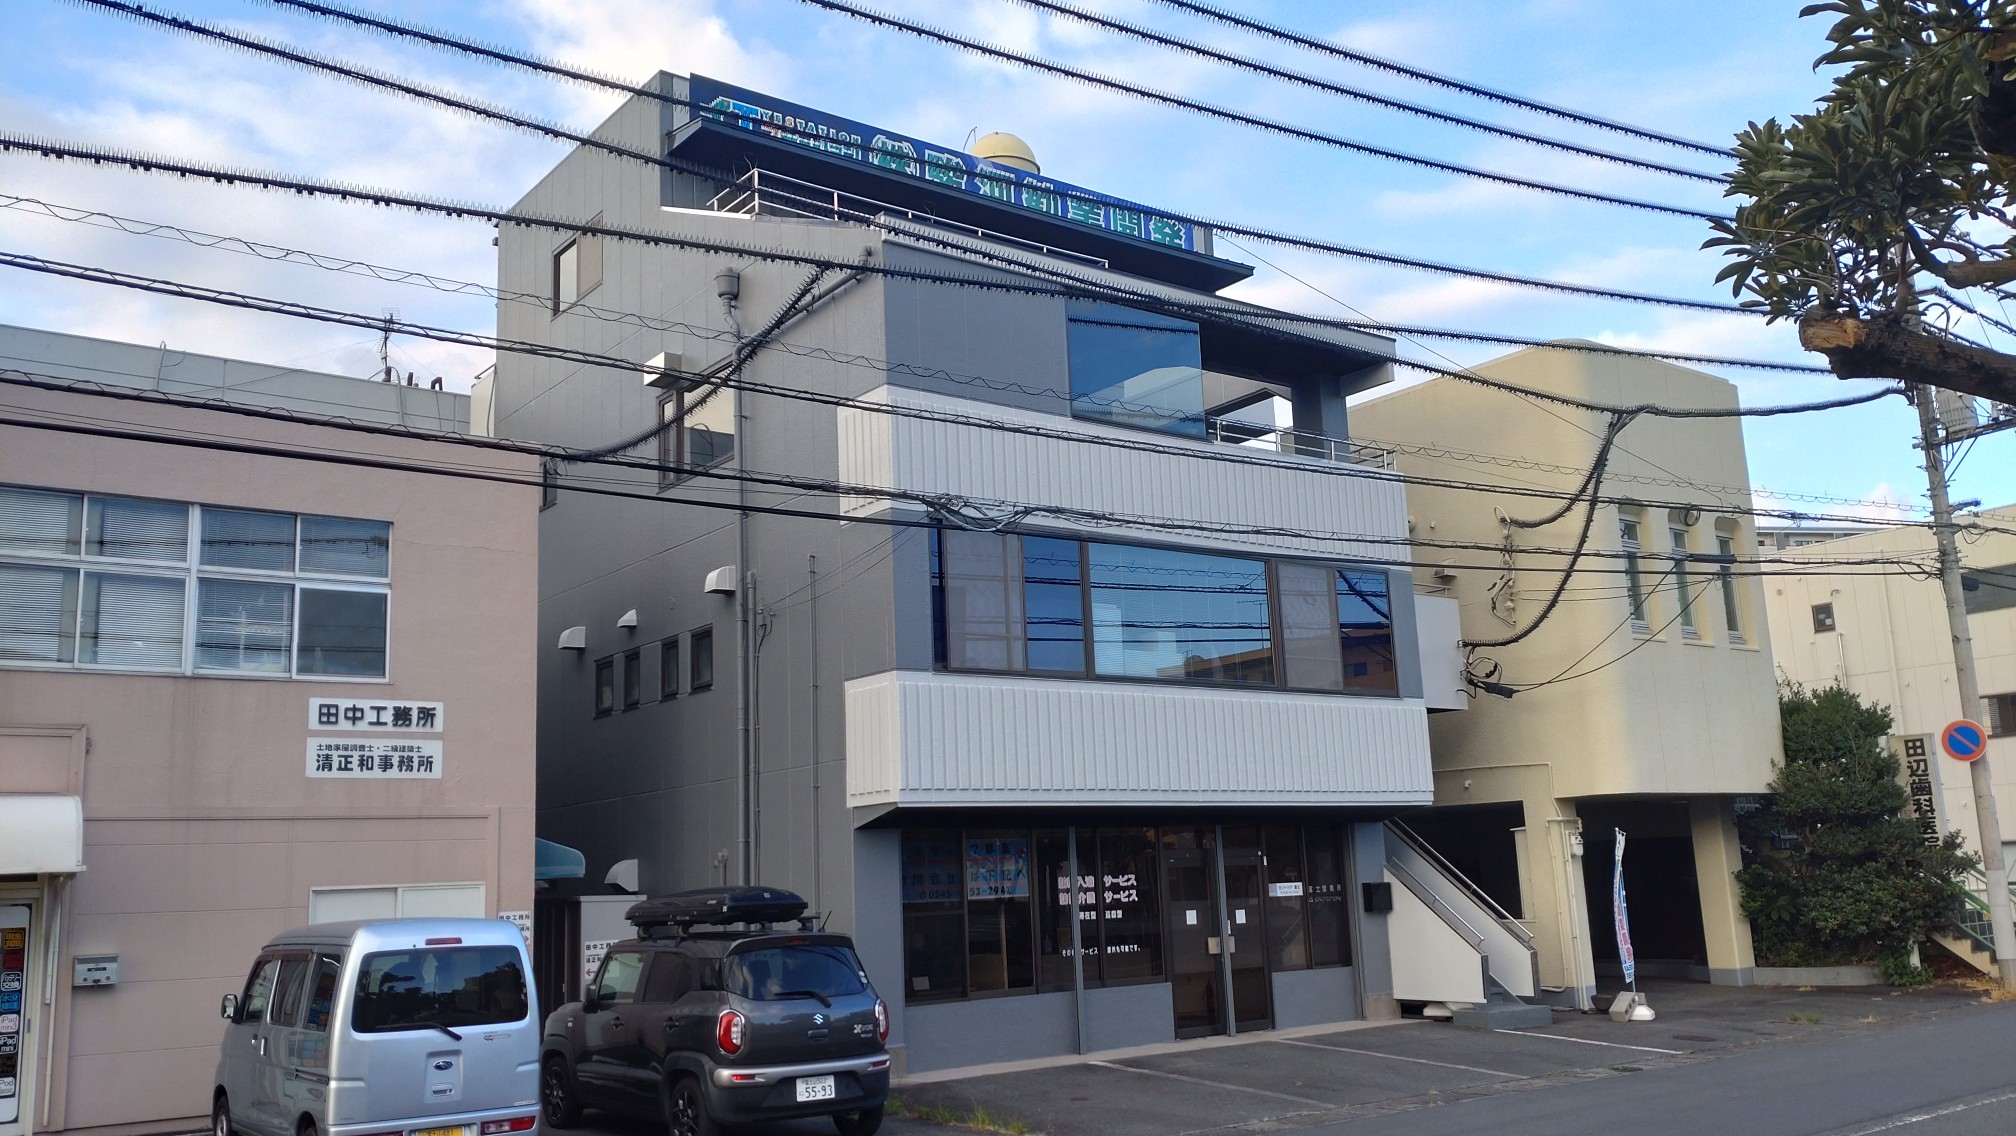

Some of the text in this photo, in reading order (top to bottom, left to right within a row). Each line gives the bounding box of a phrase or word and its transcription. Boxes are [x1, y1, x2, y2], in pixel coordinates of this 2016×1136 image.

[318, 703, 437, 728] 田中工務所
[316, 744, 423, 753] 土地家屋調査士・二級建築士
[315, 753, 434, 773] 清正和事務所
[805, 1085, 833, 1098] 55-93
